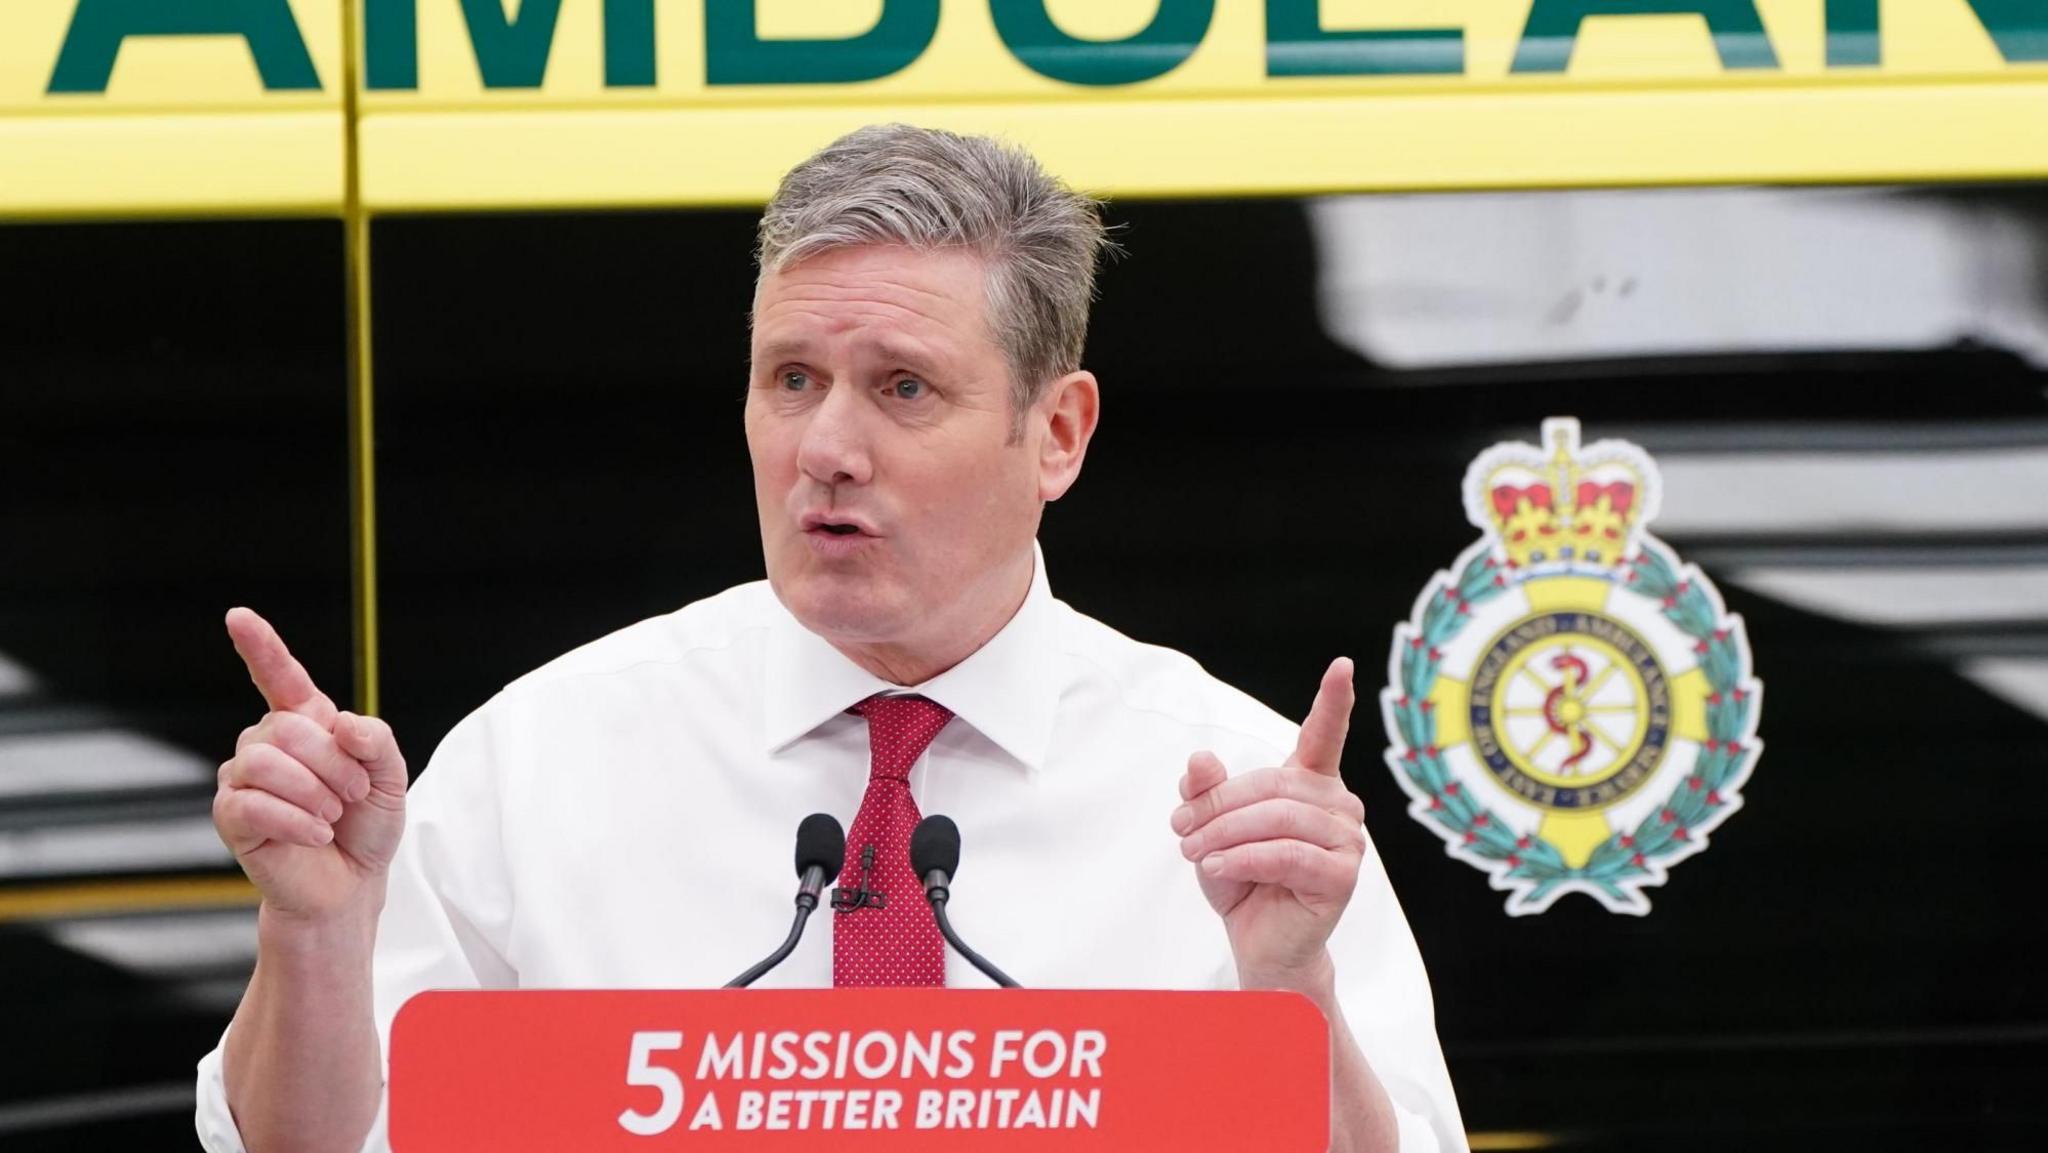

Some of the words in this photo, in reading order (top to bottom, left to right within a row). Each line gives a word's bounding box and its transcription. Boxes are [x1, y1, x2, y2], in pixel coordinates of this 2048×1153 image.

[1471, 613, 1555, 705] ENGLAND
[1575, 612, 1665, 727] AMBULANCE
[618, 1031, 684, 1136] 5
[695, 1030, 976, 1080] MISSIONS
[989, 1029, 1107, 1079] FOR
[689, 1090, 723, 1131] A
[736, 1089, 903, 1130] BETTER
[915, 1088, 1101, 1129] BRITAIN
